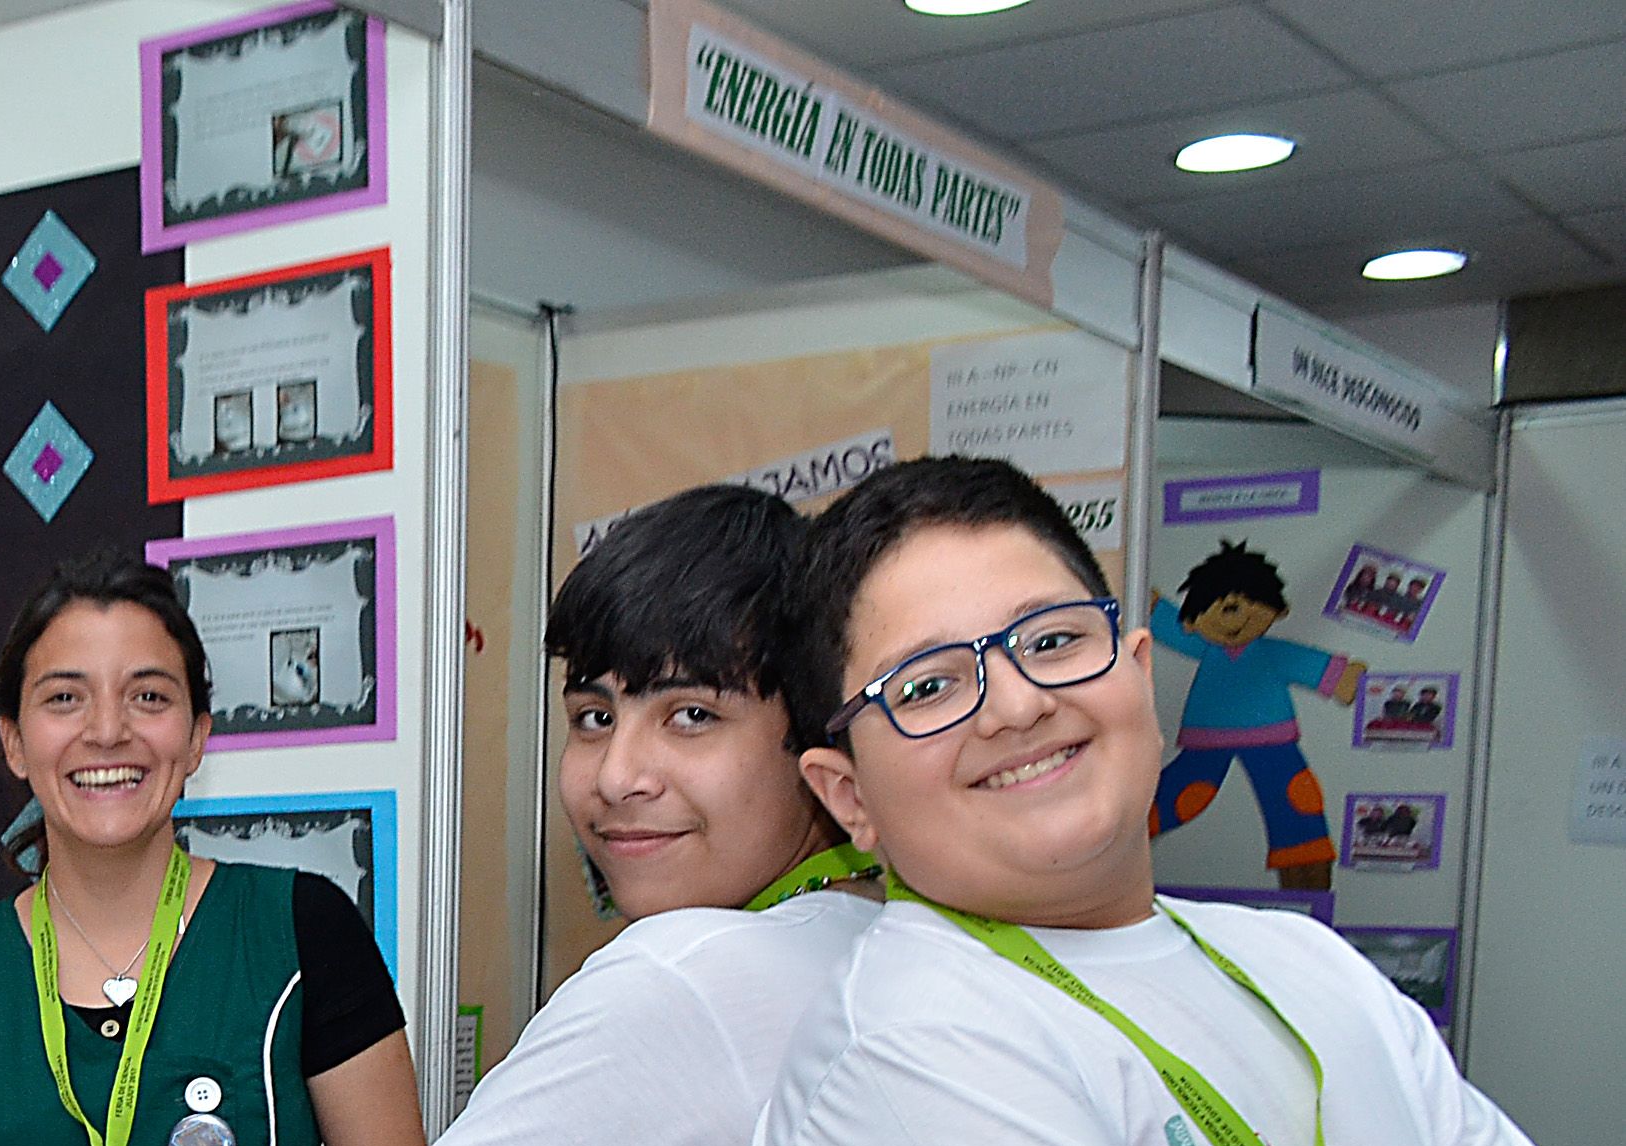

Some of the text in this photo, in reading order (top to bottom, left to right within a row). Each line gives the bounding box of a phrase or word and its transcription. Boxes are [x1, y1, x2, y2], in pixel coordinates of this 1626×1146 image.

[825, 109, 858, 175] EN
[856, 127, 927, 210] TODAS
[741, 437, 891, 497] JAMOS
[115, 1096, 123, 1118] FERIA
[120, 1056, 132, 1083] CIENCIA
